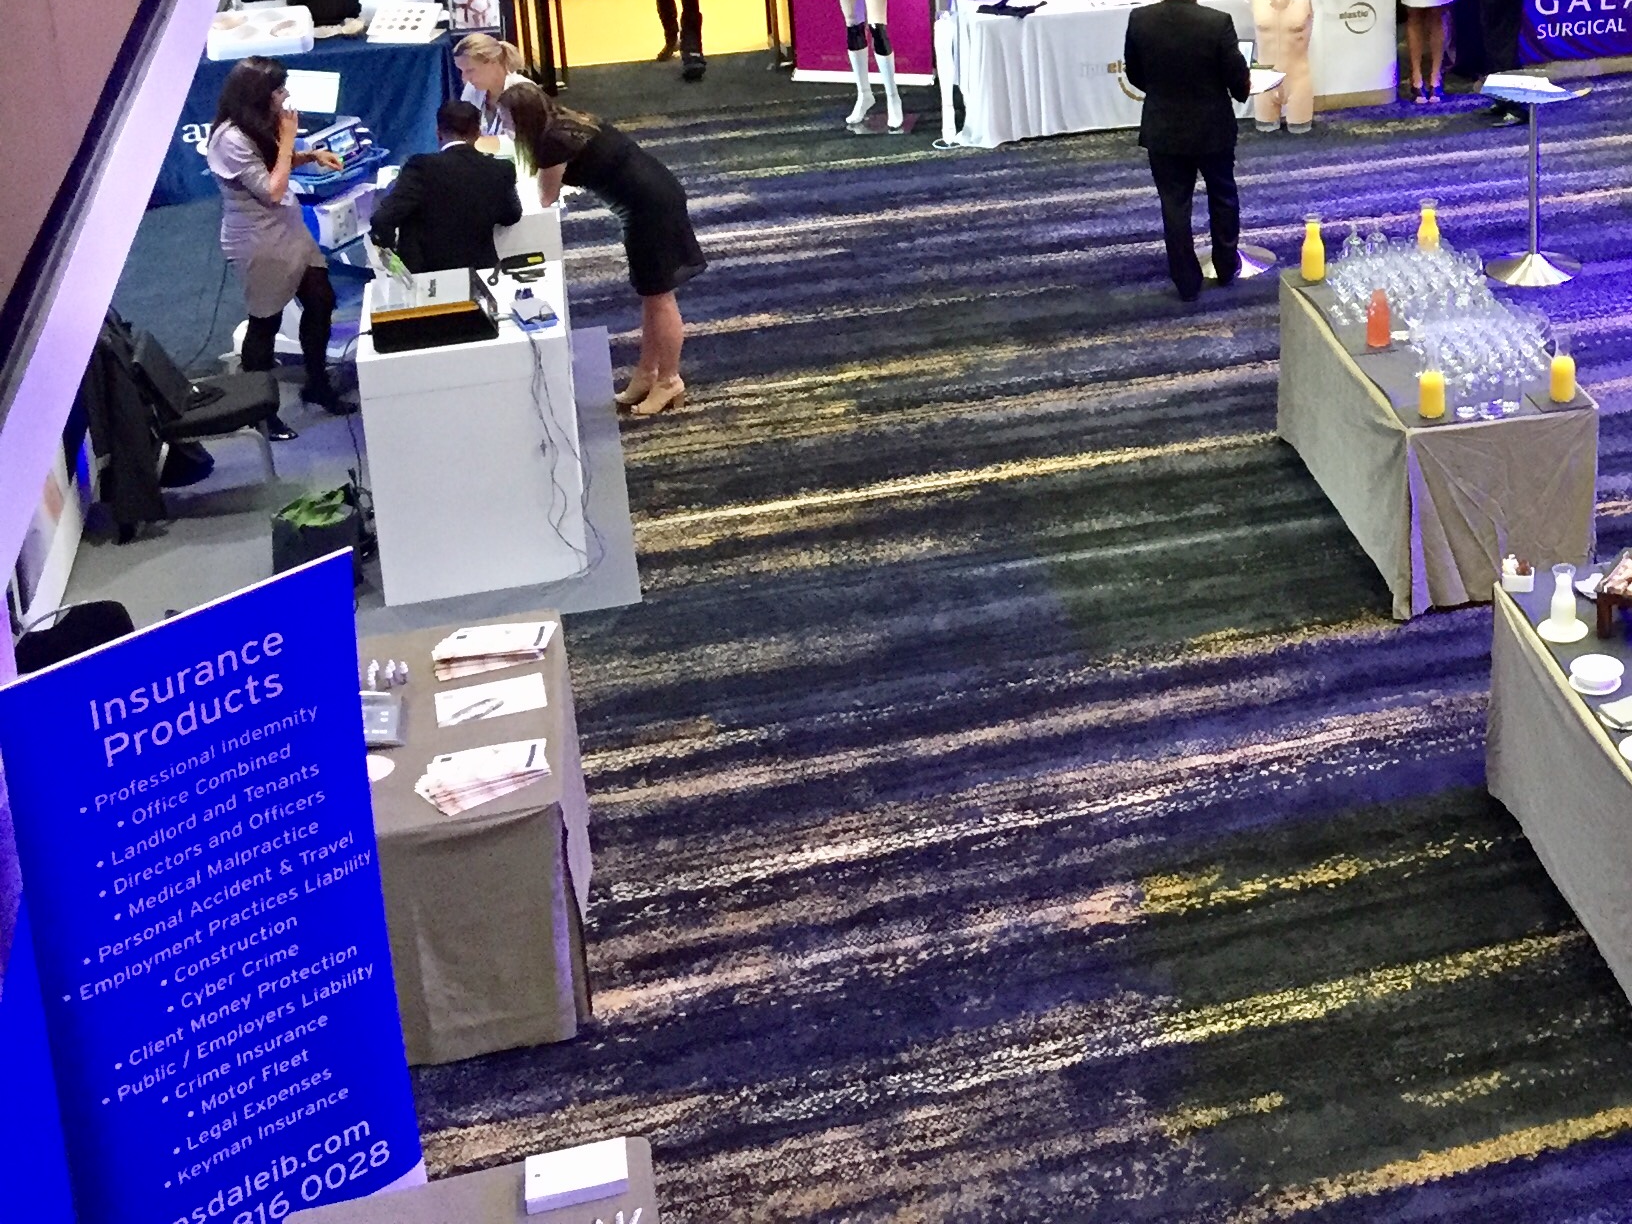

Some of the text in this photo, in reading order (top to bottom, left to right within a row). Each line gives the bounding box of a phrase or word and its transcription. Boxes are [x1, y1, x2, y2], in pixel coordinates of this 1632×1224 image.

[1537, 18, 1627, 39] SURGICAL
[89, 632, 284, 731] Insurance
[103, 673, 284, 768] Products
[94, 706, 318, 812] Professional Indemnity
[131, 743, 291, 825] Office Combined
[111, 762, 320, 866] Landlord and Tenants
[113, 789, 326, 895] Directors and Officers
[98, 830, 354, 964] Personal Accident & Travel
[128, 820, 319, 919] Medical Malpractice
[79, 849, 371, 1001] Employment Practices Liability
[174, 915, 298, 983] Construction
[129, 945, 358, 1066] Client Money Protection
[181, 943, 299, 1009] Cyber Crime
[117, 1061, 177, 1102] Public
[197, 1001, 296, 1060] Employers
[301, 962, 373, 1008] Liability
[175, 1014, 329, 1099] Crime Insurance
[187, 1067, 332, 1151] Legal Expenses
[201, 1048, 310, 1115] Motor Fleet
[178, 1087, 349, 1185] Keyman Insurance
[300, 1140, 390, 1202] 0028
